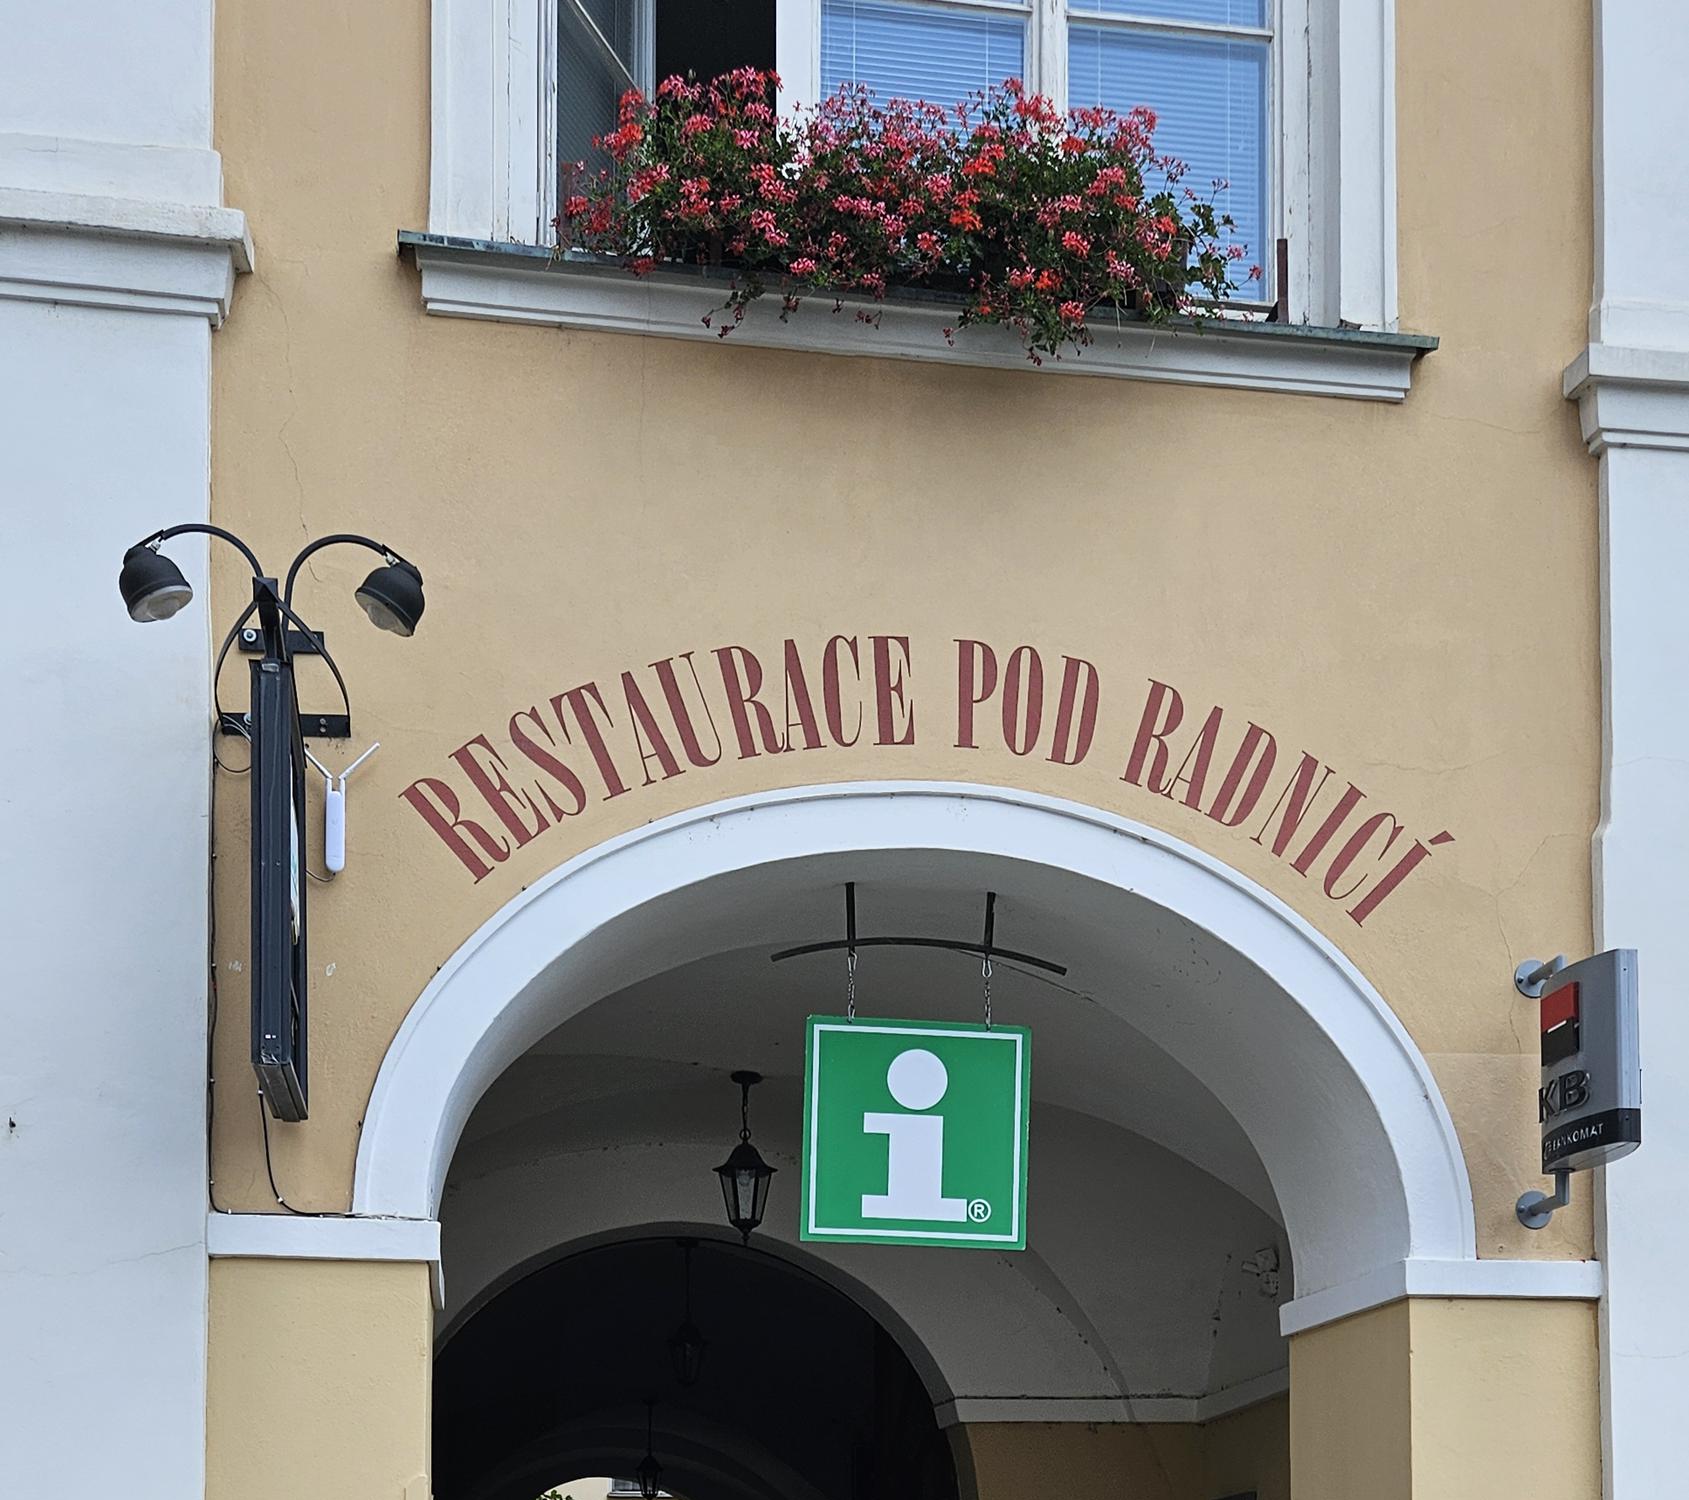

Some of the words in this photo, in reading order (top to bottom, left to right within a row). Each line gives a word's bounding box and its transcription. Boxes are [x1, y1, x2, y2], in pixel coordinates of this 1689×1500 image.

[399, 634, 917, 884] RESTAURACE
[953, 638, 1099, 766] POD
[1120, 679, 1456, 927] RADNICÍ
[1539, 1070, 1590, 1123] KB
